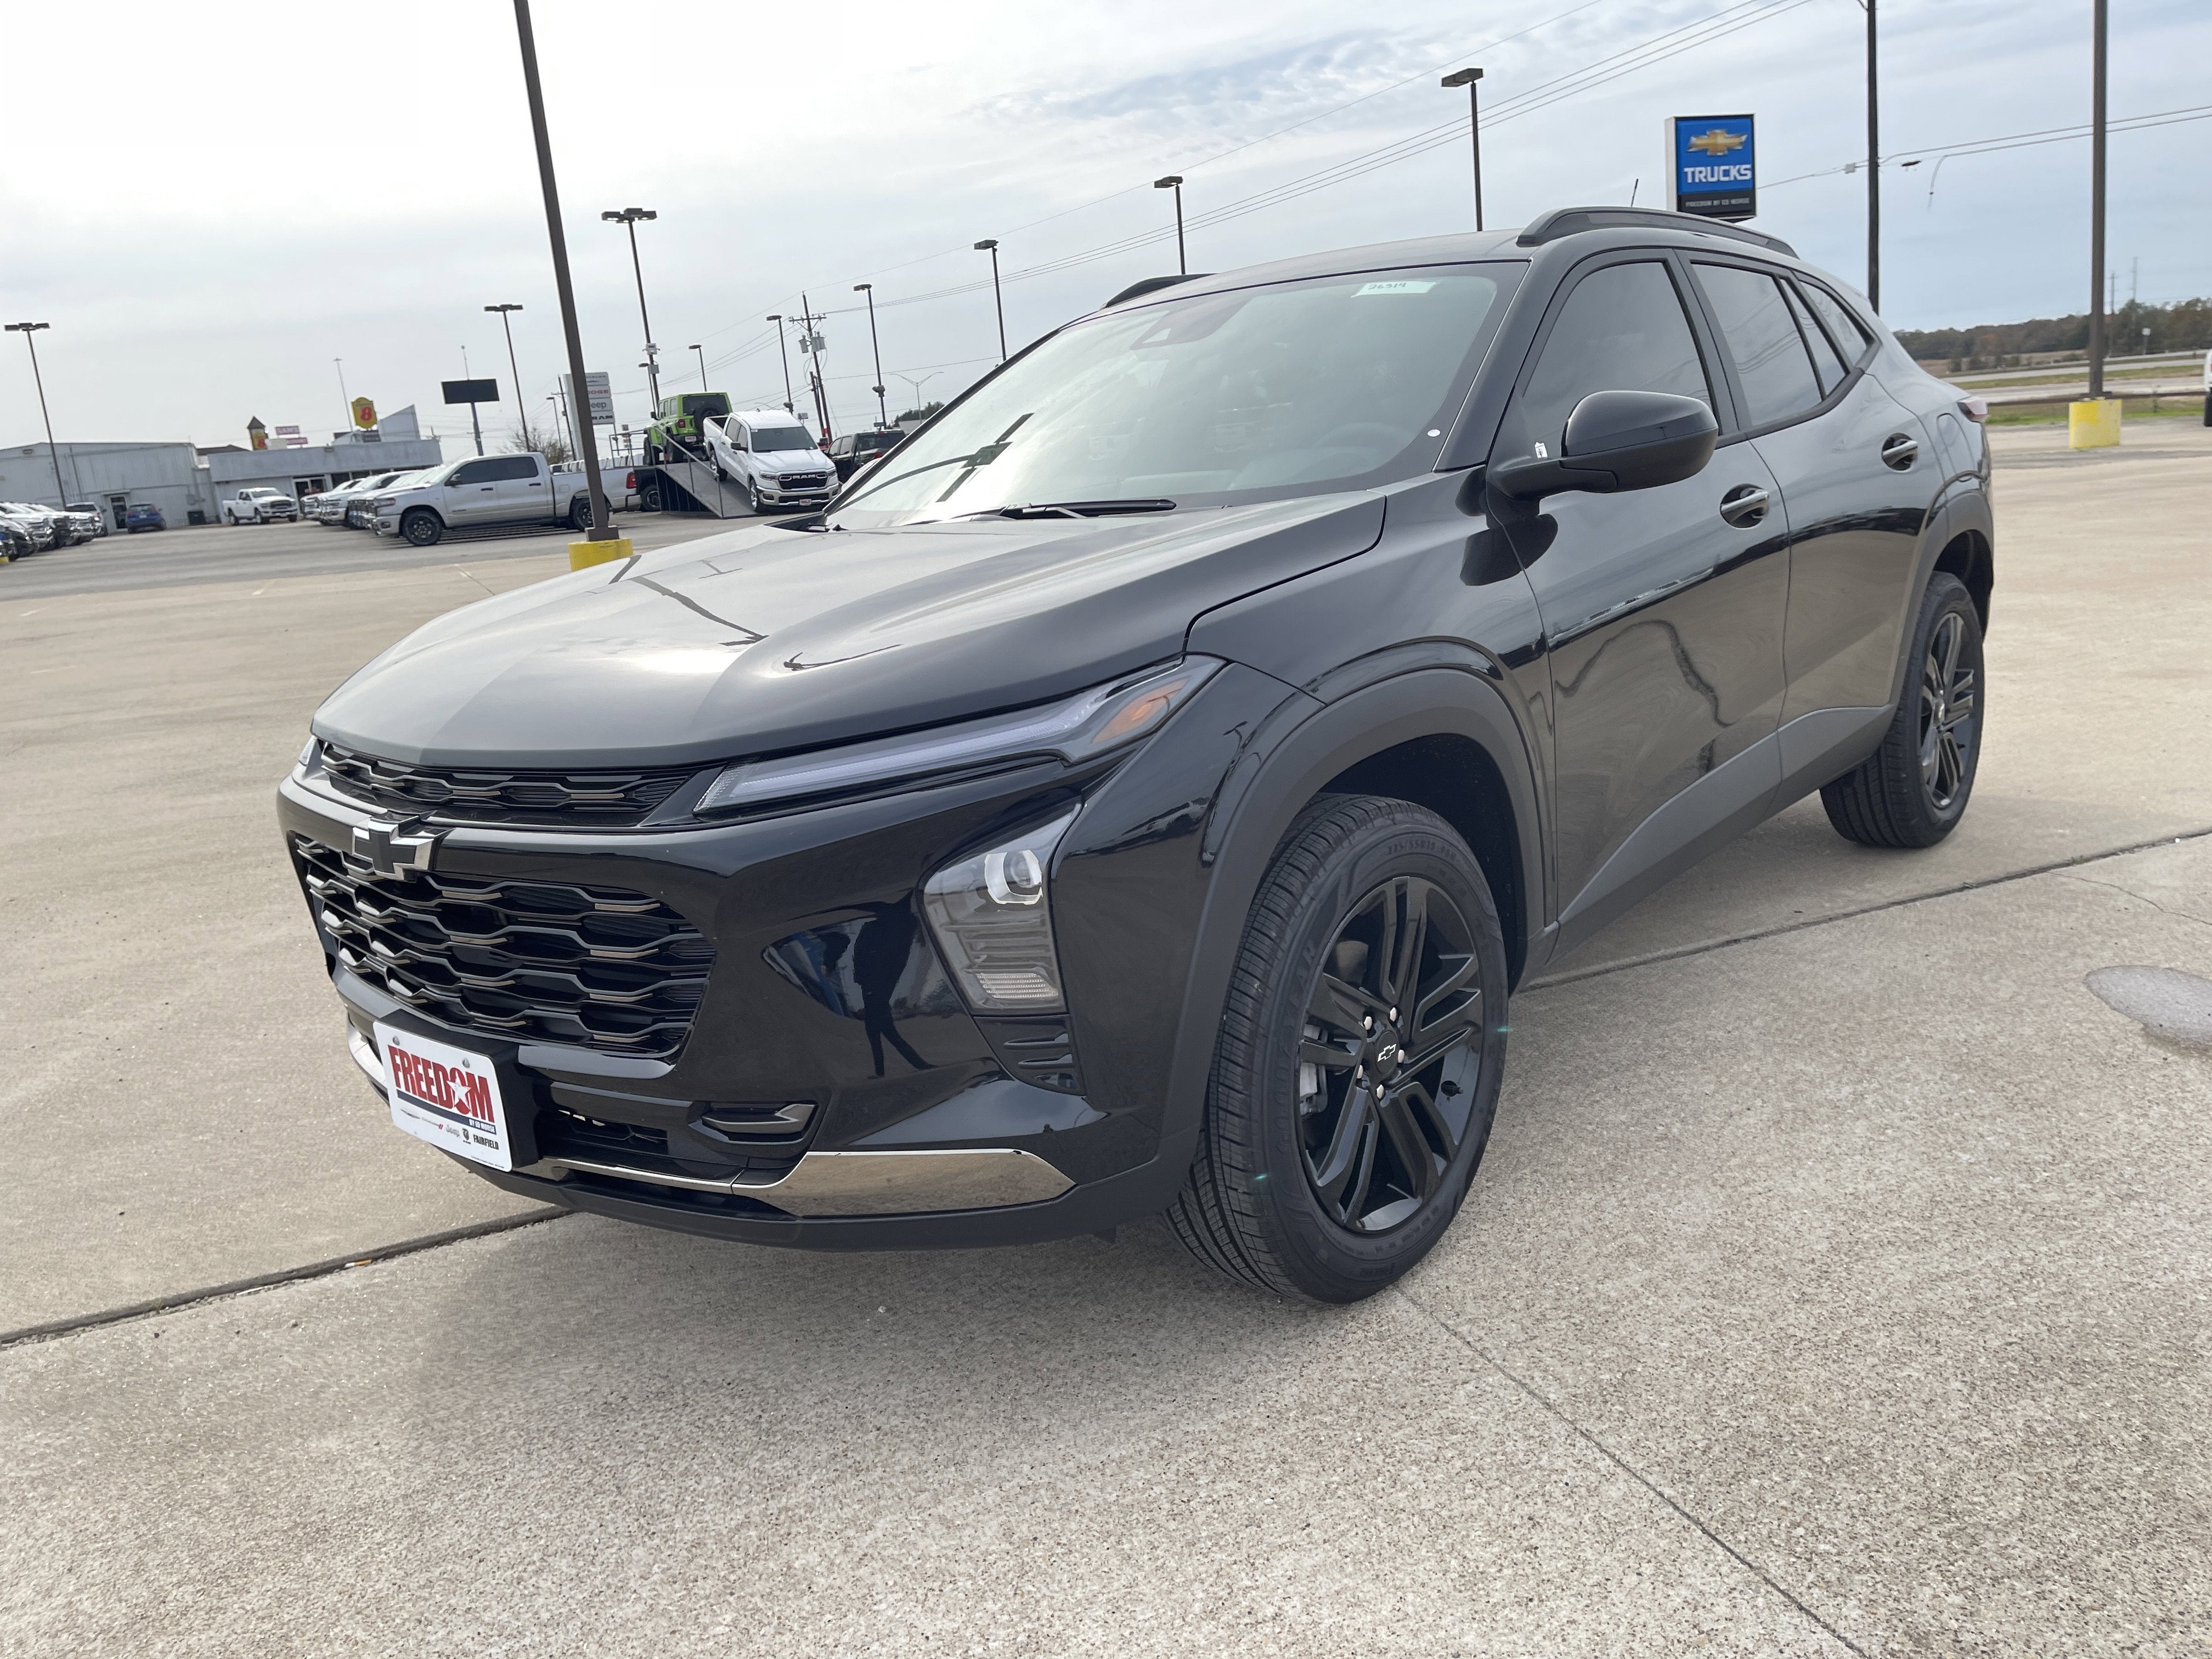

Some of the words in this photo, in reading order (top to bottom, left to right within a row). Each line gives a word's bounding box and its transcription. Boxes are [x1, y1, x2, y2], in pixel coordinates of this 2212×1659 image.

[1684, 164, 1752, 183] TRUCKS
[360, 406, 372, 421] 8
[387, 1044, 495, 1124] FREEDOM
[473, 1133, 499, 1150] FAIRFIELD
